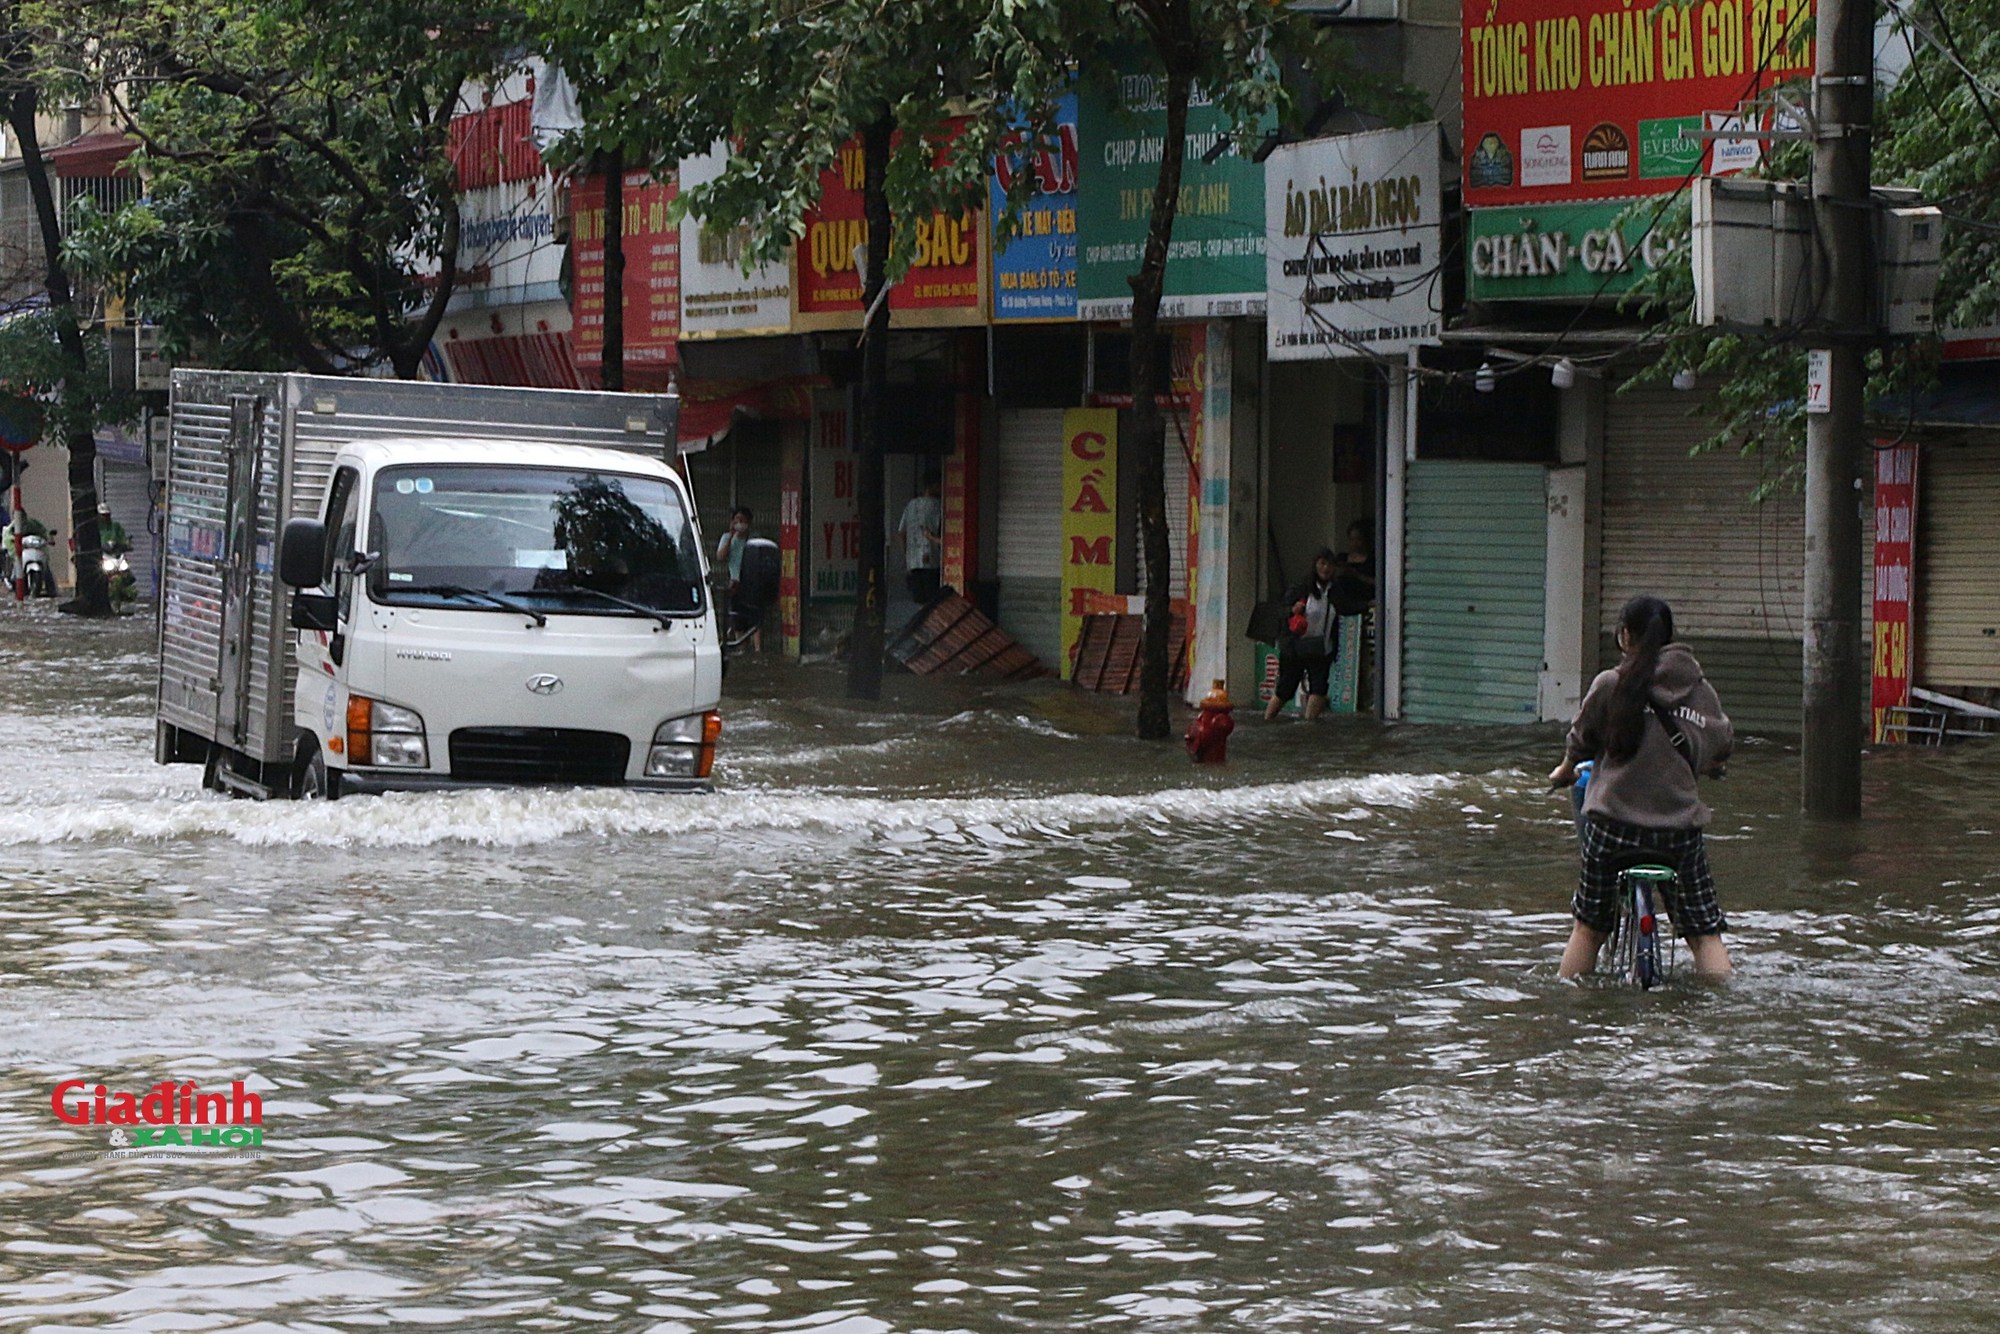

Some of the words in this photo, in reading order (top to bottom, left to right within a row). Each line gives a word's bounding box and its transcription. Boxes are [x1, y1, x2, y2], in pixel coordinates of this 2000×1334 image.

[1470, 0, 1528, 97] TỔNG
[1536, 15, 1582, 92] KHO
[1662, 4, 1696, 81] GA
[1104, 139, 1136, 171] CHỤP
[1138, 130, 1165, 163] ẢNH
[1643, 136, 1700, 156] EVERON
[1119, 188, 1138, 221] IN
[823, 522, 835, 560] Y
